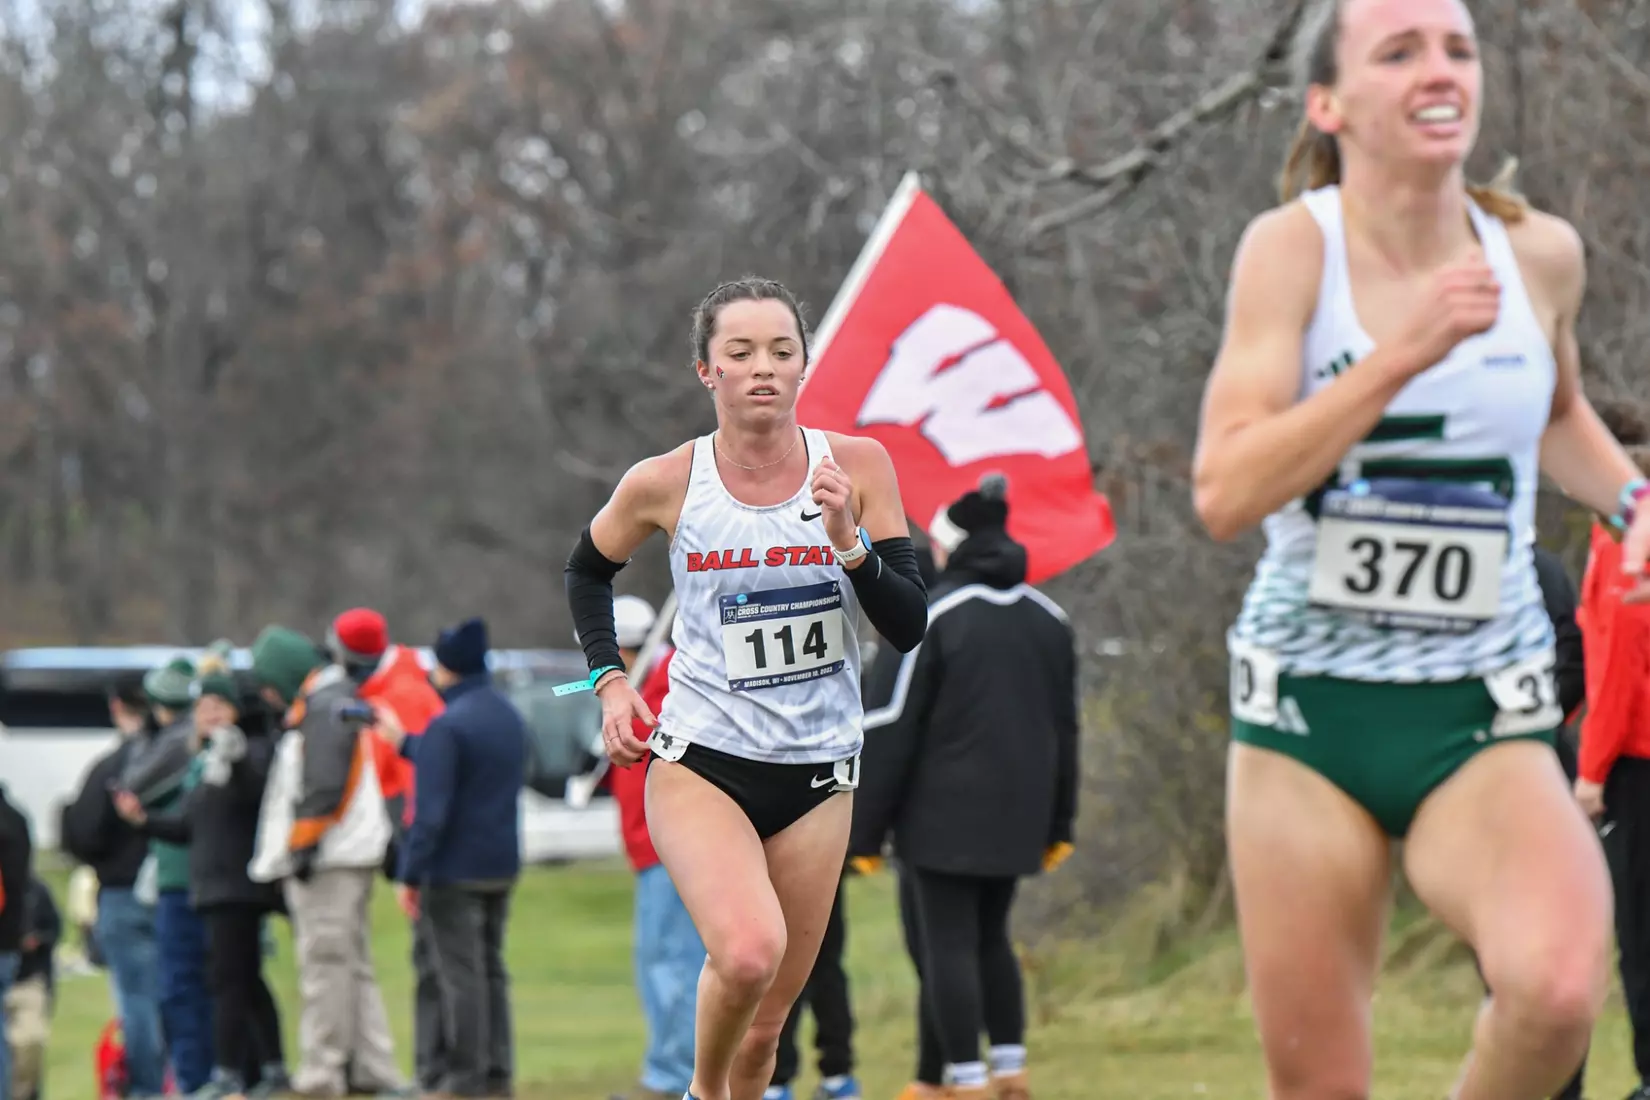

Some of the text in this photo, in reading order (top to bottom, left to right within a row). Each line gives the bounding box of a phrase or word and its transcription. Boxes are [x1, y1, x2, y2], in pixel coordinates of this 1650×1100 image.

[687, 545, 842, 572] BALL STAT
[1344, 537, 1473, 602] 370
[737, 605, 759, 616] CROSS
[760, 603, 790, 613] COUNTRY
[790, 594, 840, 610] CHAMPIONSHIPS
[745, 620, 828, 669] 114
[1518, 671, 1549, 715] 3
[845, 755, 860, 783] 1
